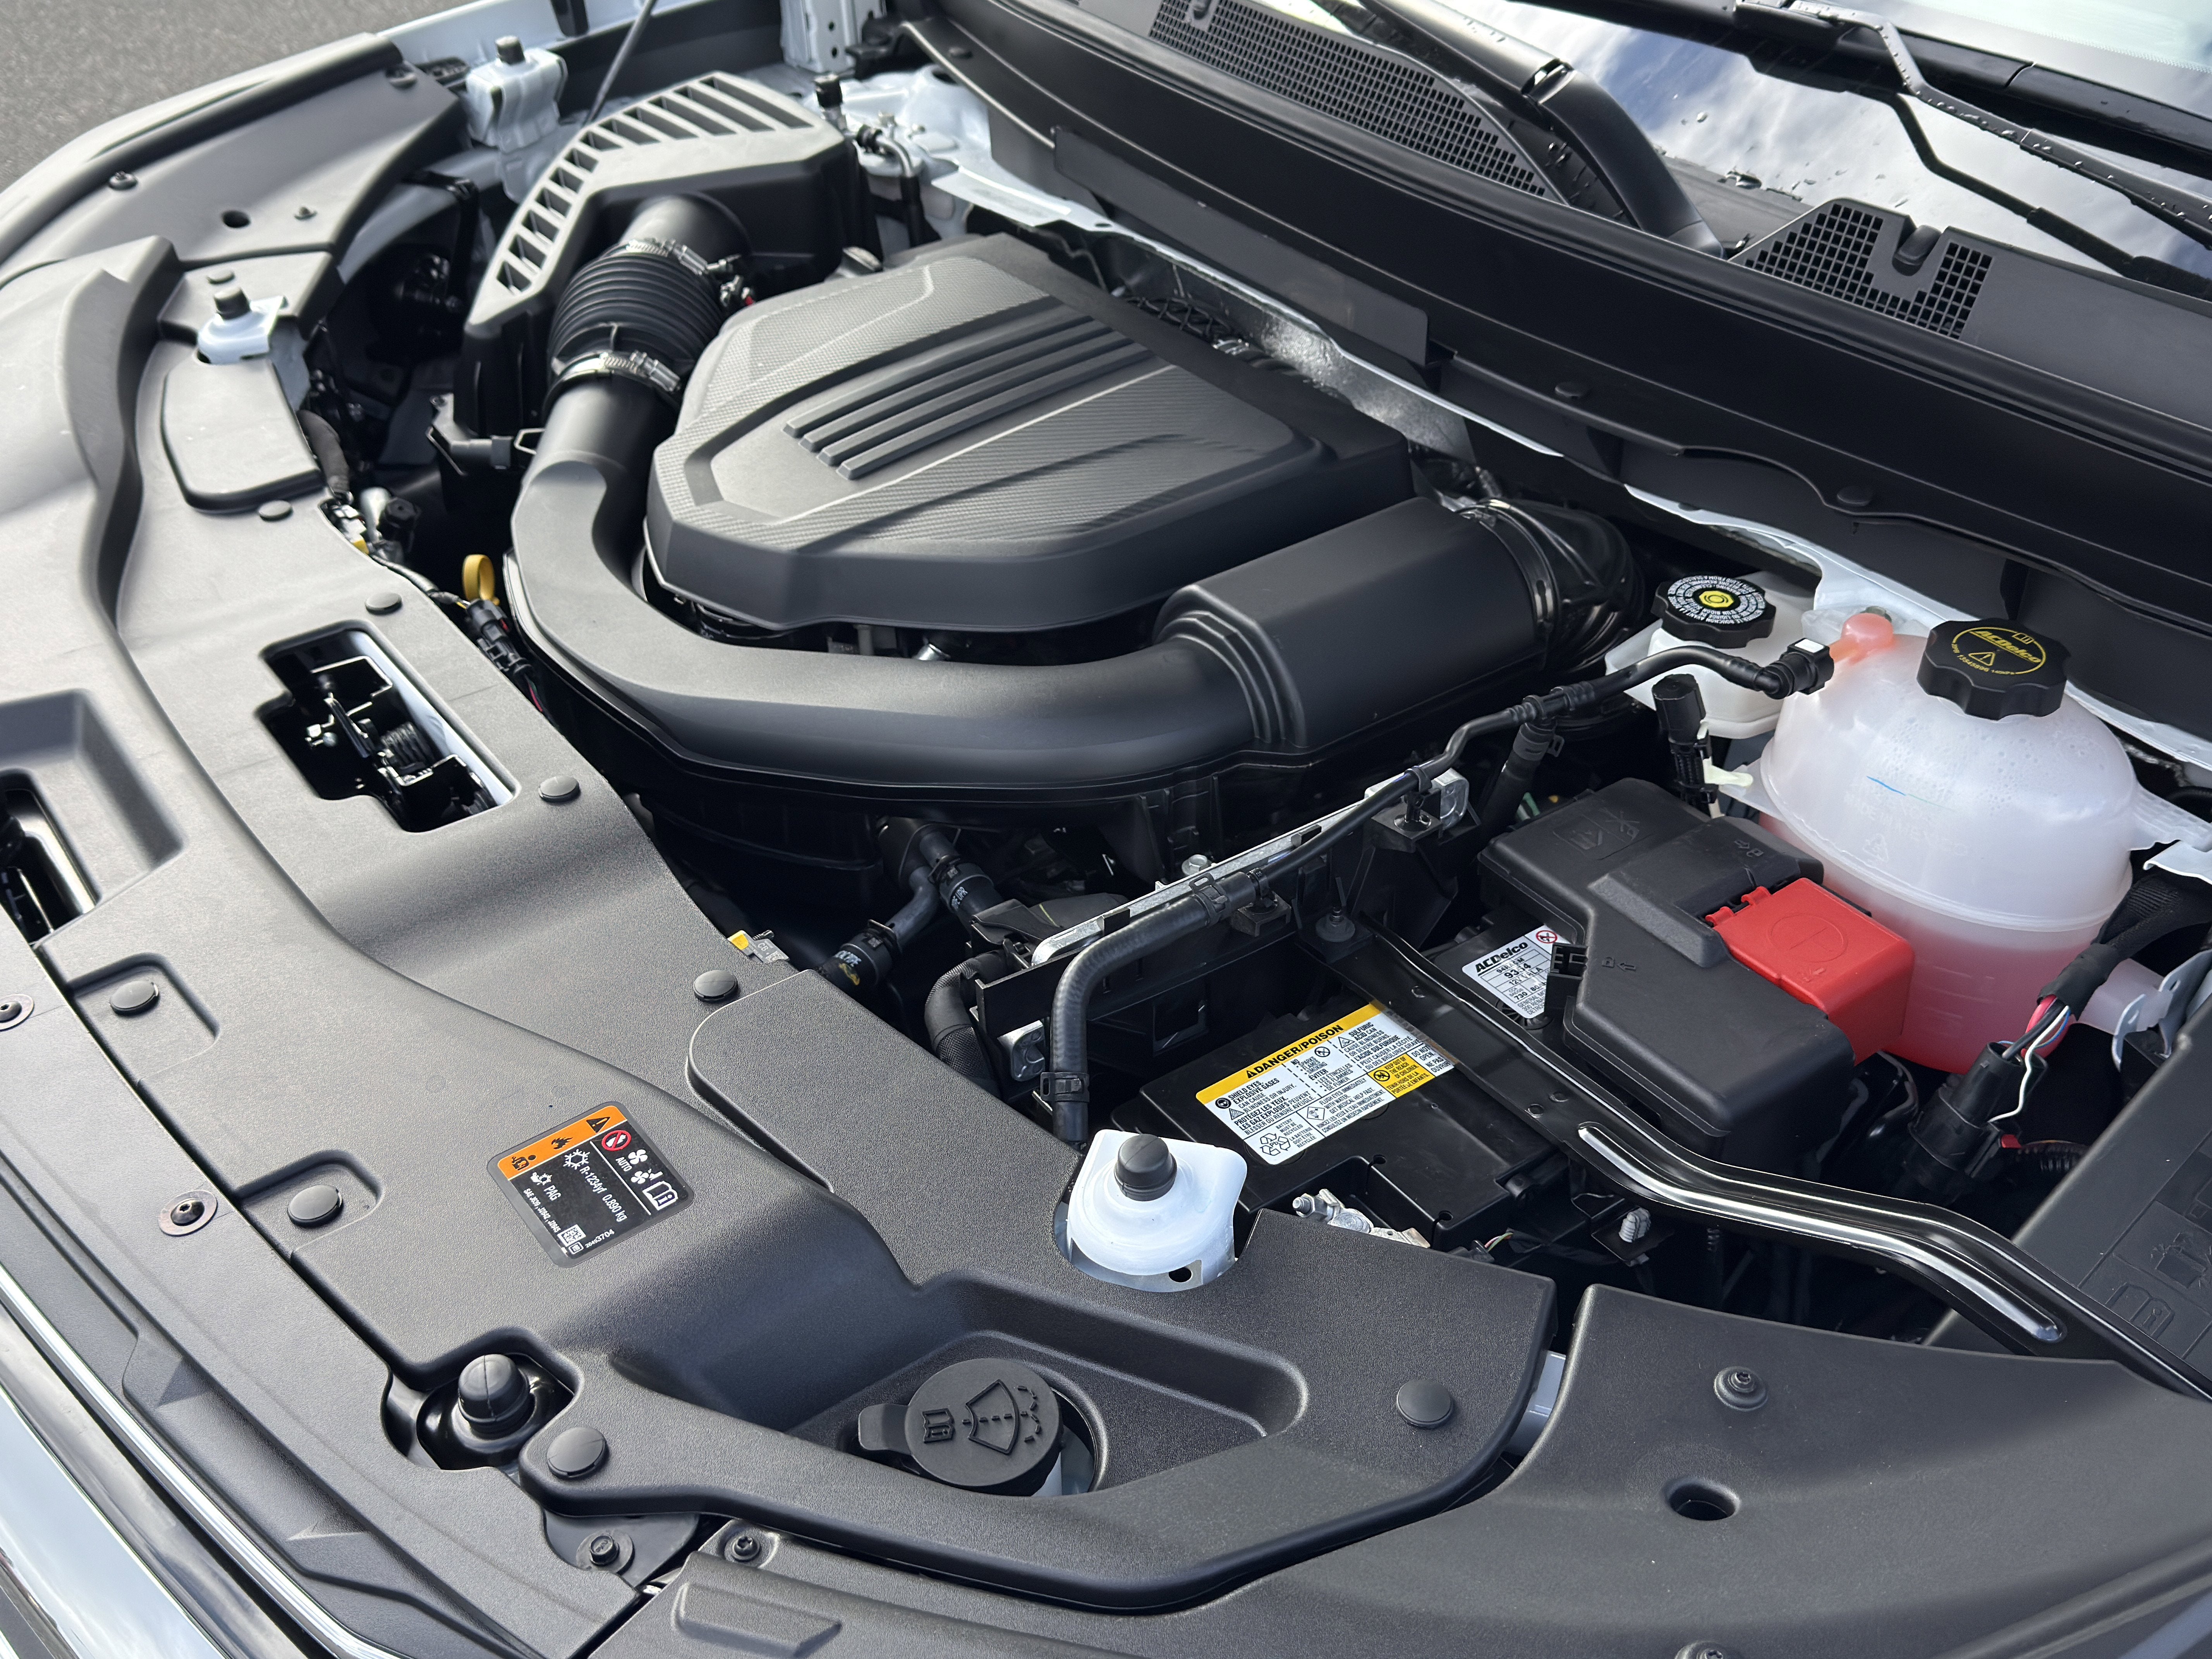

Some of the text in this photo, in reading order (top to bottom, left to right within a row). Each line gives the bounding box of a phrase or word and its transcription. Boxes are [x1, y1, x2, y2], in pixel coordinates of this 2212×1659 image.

[1976, 631, 2041, 663] ACDelco
[758, 943, 769, 951] CB
[1475, 942, 1528, 972] ACDelco
[1508, 977, 1523, 986] 12V
[1513, 991, 1528, 1000] 730
[1516, 995, 1539, 1008] GENERAL
[1348, 1022, 1374, 1037] SULFURIC
[1353, 1032, 1367, 1041] ACID
[1344, 1030, 1384, 1053] CAUSE BLINDNESS
[1353, 1035, 1401, 1061] L'ACIDE SULFURIQUE
[1355, 1041, 1375, 1053] SEVERE
[1372, 1033, 1391, 1044] BURNS.
[1403, 1038, 1421, 1049] GRAVE
[1253, 1024, 1343, 1074] DANGER/POISON
[1360, 1057, 1374, 1066] PEUT
[1371, 1048, 1391, 1060] CAUSER
[1394, 1035, 1413, 1047] CÉCITÉ
[1418, 1045, 1430, 1053] NOT
[1298, 1056, 1316, 1067] SPARKS
[1302, 1059, 1321, 1070] FLAMES
[1306, 1061, 1328, 1074] SMOKING
[1395, 1061, 1410, 1071] REACH
[1307, 1067, 1329, 1080] ÉVITER
[1330, 1068, 1353, 1082] FLAMMES
[1333, 1076, 1350, 1087] FUMER
[1386, 1082, 1399, 1090] TENIR
[1396, 1077, 1409, 1085] HORS
[1228, 1079, 1264, 1100] SHIELD EYES.
[1233, 1077, 1280, 1104] EXPLOSIVE GASES
[1353, 1092, 1365, 1100] HELP
[1238, 1092, 1266, 1109] CAN CAUSE
[1243, 1096, 1271, 1113] BLINDNESS
[1276, 1082, 1297, 1095] INJURY.
[1319, 1096, 1333, 1105] FLUSH
[1331, 1090, 1343, 1098] EYES
[1233, 1095, 1288, 1126] PROTÉGEZ LES YEUX.
[1239, 1091, 1311, 1130] LES GAZ EXPLOSIFS PEUVENT
[1324, 1101, 1336, 1109] WITH
[1244, 1121, 1267, 1135] BLESSER
[1273, 1106, 1294, 1119] RENDRE
[1291, 1095, 1316, 1109] AVEUGLE.
[1275, 1118, 1293, 1129] BATTERY
[1279, 1125, 1291, 1133] MUST
[1283, 1124, 1304, 1136] RECYCLED
[1293, 1127, 1312, 1138] BATTERIE
[615, 1156, 632, 1172] AUTO
[543, 1185, 562, 1201] PAG
[577, 1165, 629, 1222] R-1234yf 0.890 kg
[522, 1188, 534, 1198] SAE
[546, 1219, 562, 1233] J2845
[582, 1228, 615, 1248] 26493704
